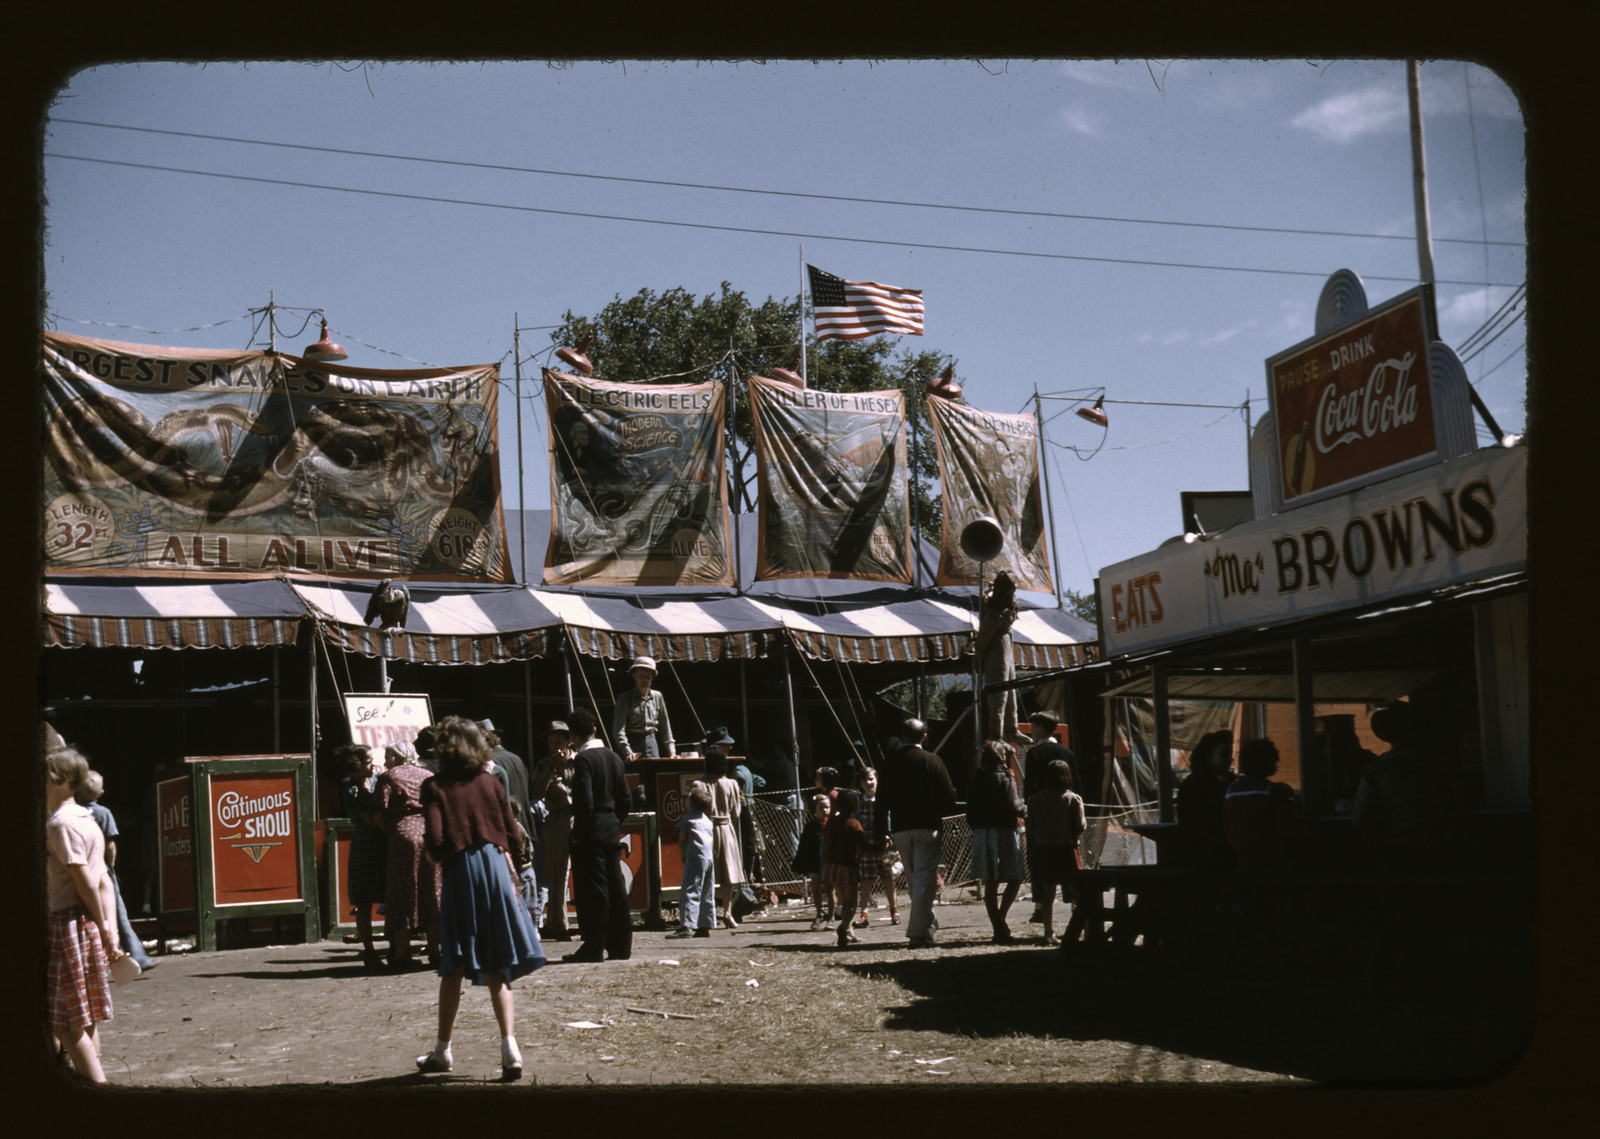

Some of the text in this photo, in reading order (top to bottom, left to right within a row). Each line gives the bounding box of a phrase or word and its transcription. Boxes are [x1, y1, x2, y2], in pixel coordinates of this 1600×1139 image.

[1330, 333, 1375, 370] DRINK
[40, 346, 482, 400] ARGEST SNAKES ON EARTH
[559, 383, 712, 410] ELECTRIC EELS
[831, 396, 849, 409] OF
[1315, 350, 1418, 454] Coca-Cola
[620, 416, 663, 436] MODERN
[626, 430, 679, 450] SCIENCE
[50, 503, 109, 522] LENGTH
[437, 516, 478, 532] WEIGHT
[53, 520, 94, 550] 32
[438, 532, 475, 559] 618
[672, 540, 709, 557] ALIVE
[1271, 474, 1497, 596] BROWNS
[158, 535, 392, 571] ALL ALIVE
[1110, 571, 1165, 634] EATS
[163, 794, 190, 831] LIVE
[217, 791, 292, 828] Continuous
[244, 809, 292, 838] SHOW
